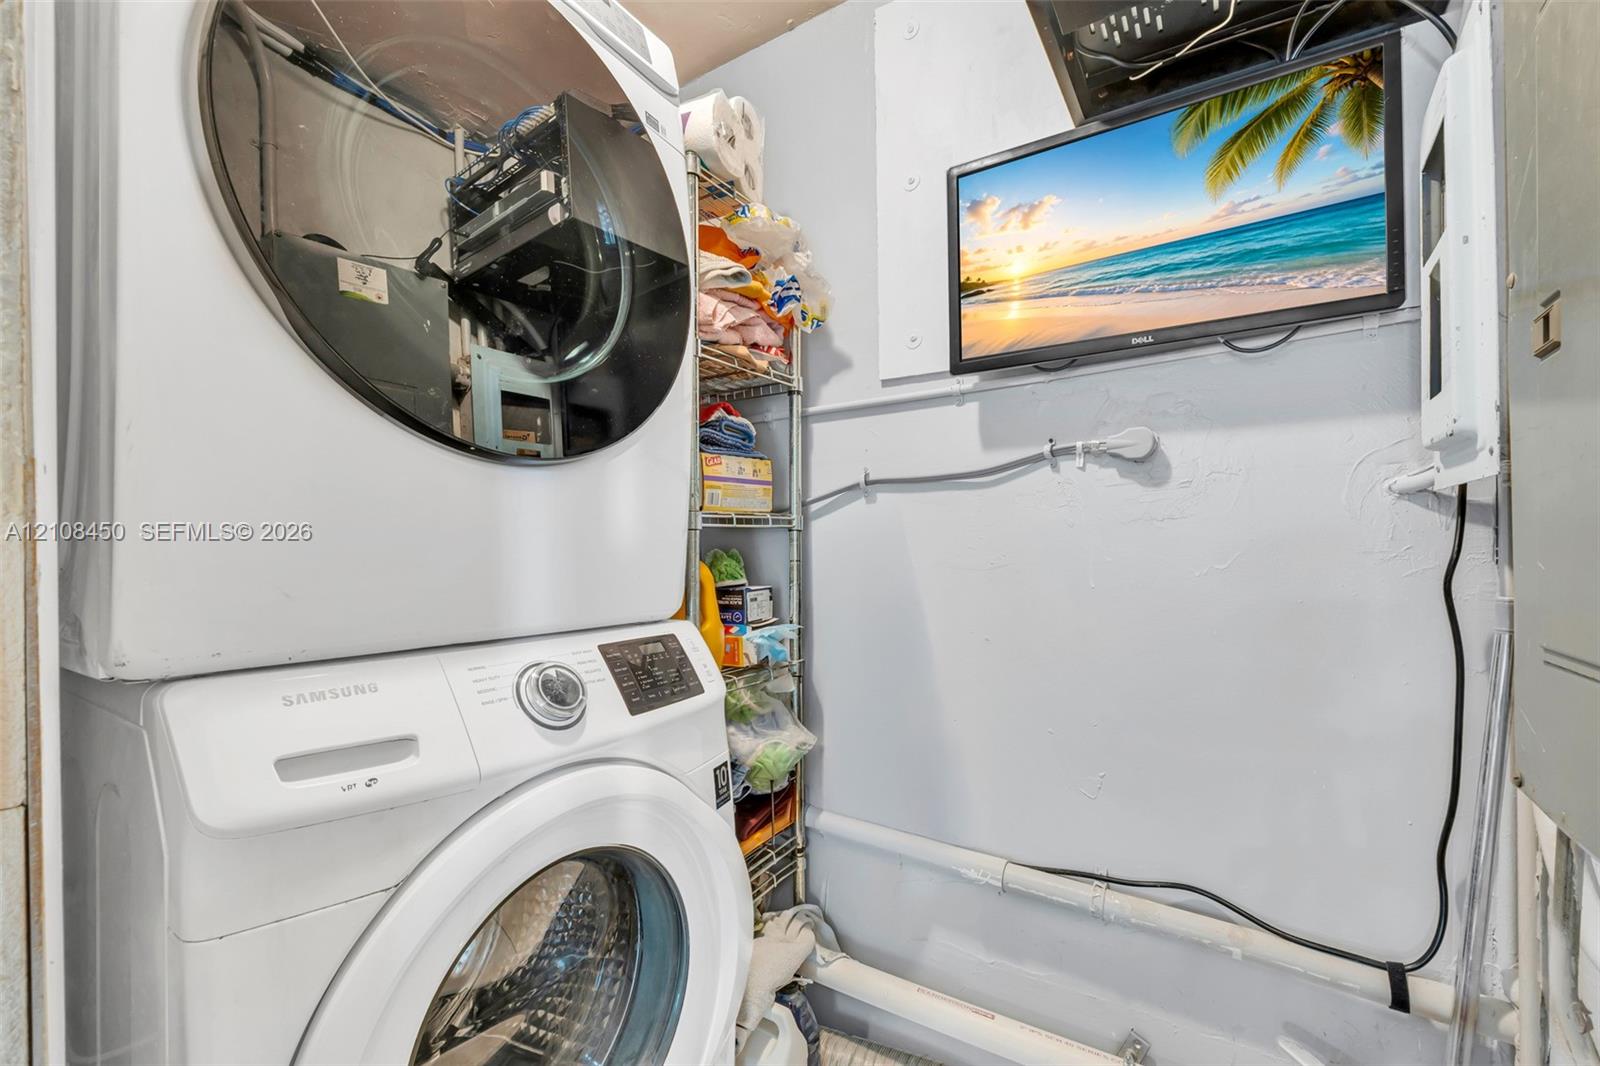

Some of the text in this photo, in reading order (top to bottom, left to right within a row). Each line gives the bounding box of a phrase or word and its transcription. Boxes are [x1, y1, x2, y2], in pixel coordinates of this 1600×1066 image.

[1131, 335, 1155, 345] DELL
[705, 455, 722, 466] GLAD
[281, 682, 379, 707] SAMSUNG
[716, 766, 728, 789] 10
